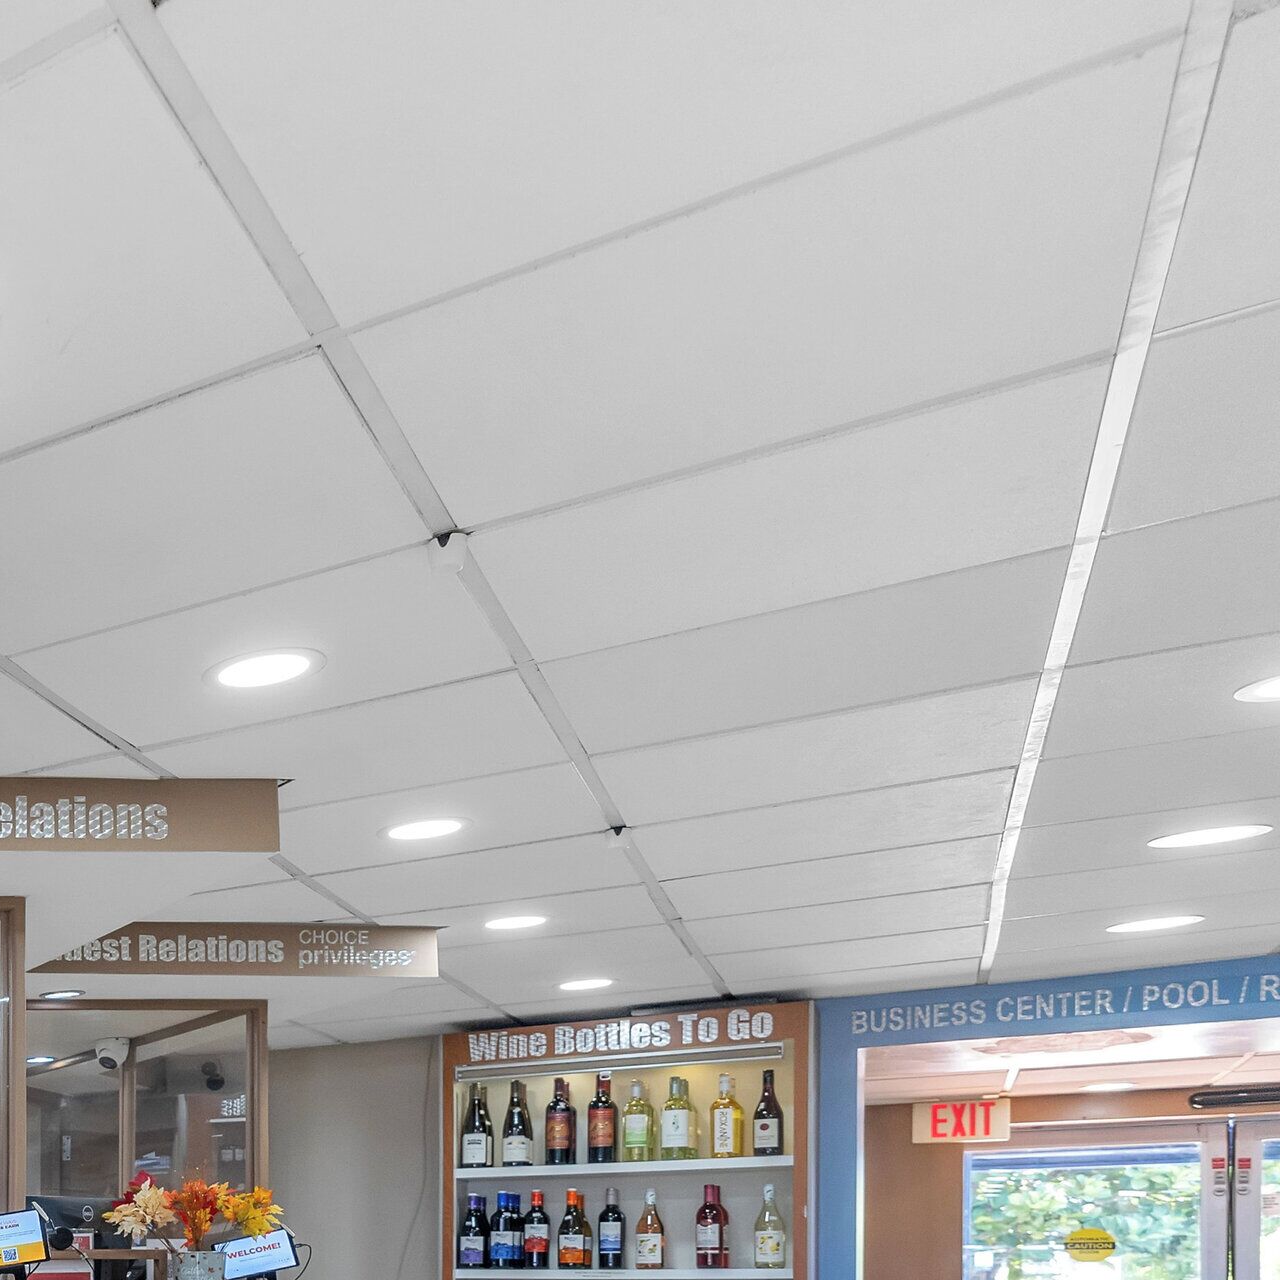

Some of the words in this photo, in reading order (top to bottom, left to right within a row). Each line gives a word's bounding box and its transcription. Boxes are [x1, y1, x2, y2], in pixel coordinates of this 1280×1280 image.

[138, 934, 284, 964] Relations
[298, 929, 369, 946] CHOICE
[298, 945, 416, 969] privileges
[851, 1000, 987, 1035] BUSINESS
[996, 989, 1114, 1023] CENTER
[1123, 986, 1133, 1013] /
[1142, 979, 1229, 1011] POOL
[468, 1030, 547, 1062] Wine
[554, 1019, 671, 1055] Bottles
[677, 1013, 718, 1045] To
[727, 1008, 773, 1041] Go
[930, 1101, 996, 1138] EXIT
[227, 1242, 281, 1259] WELCOME!
